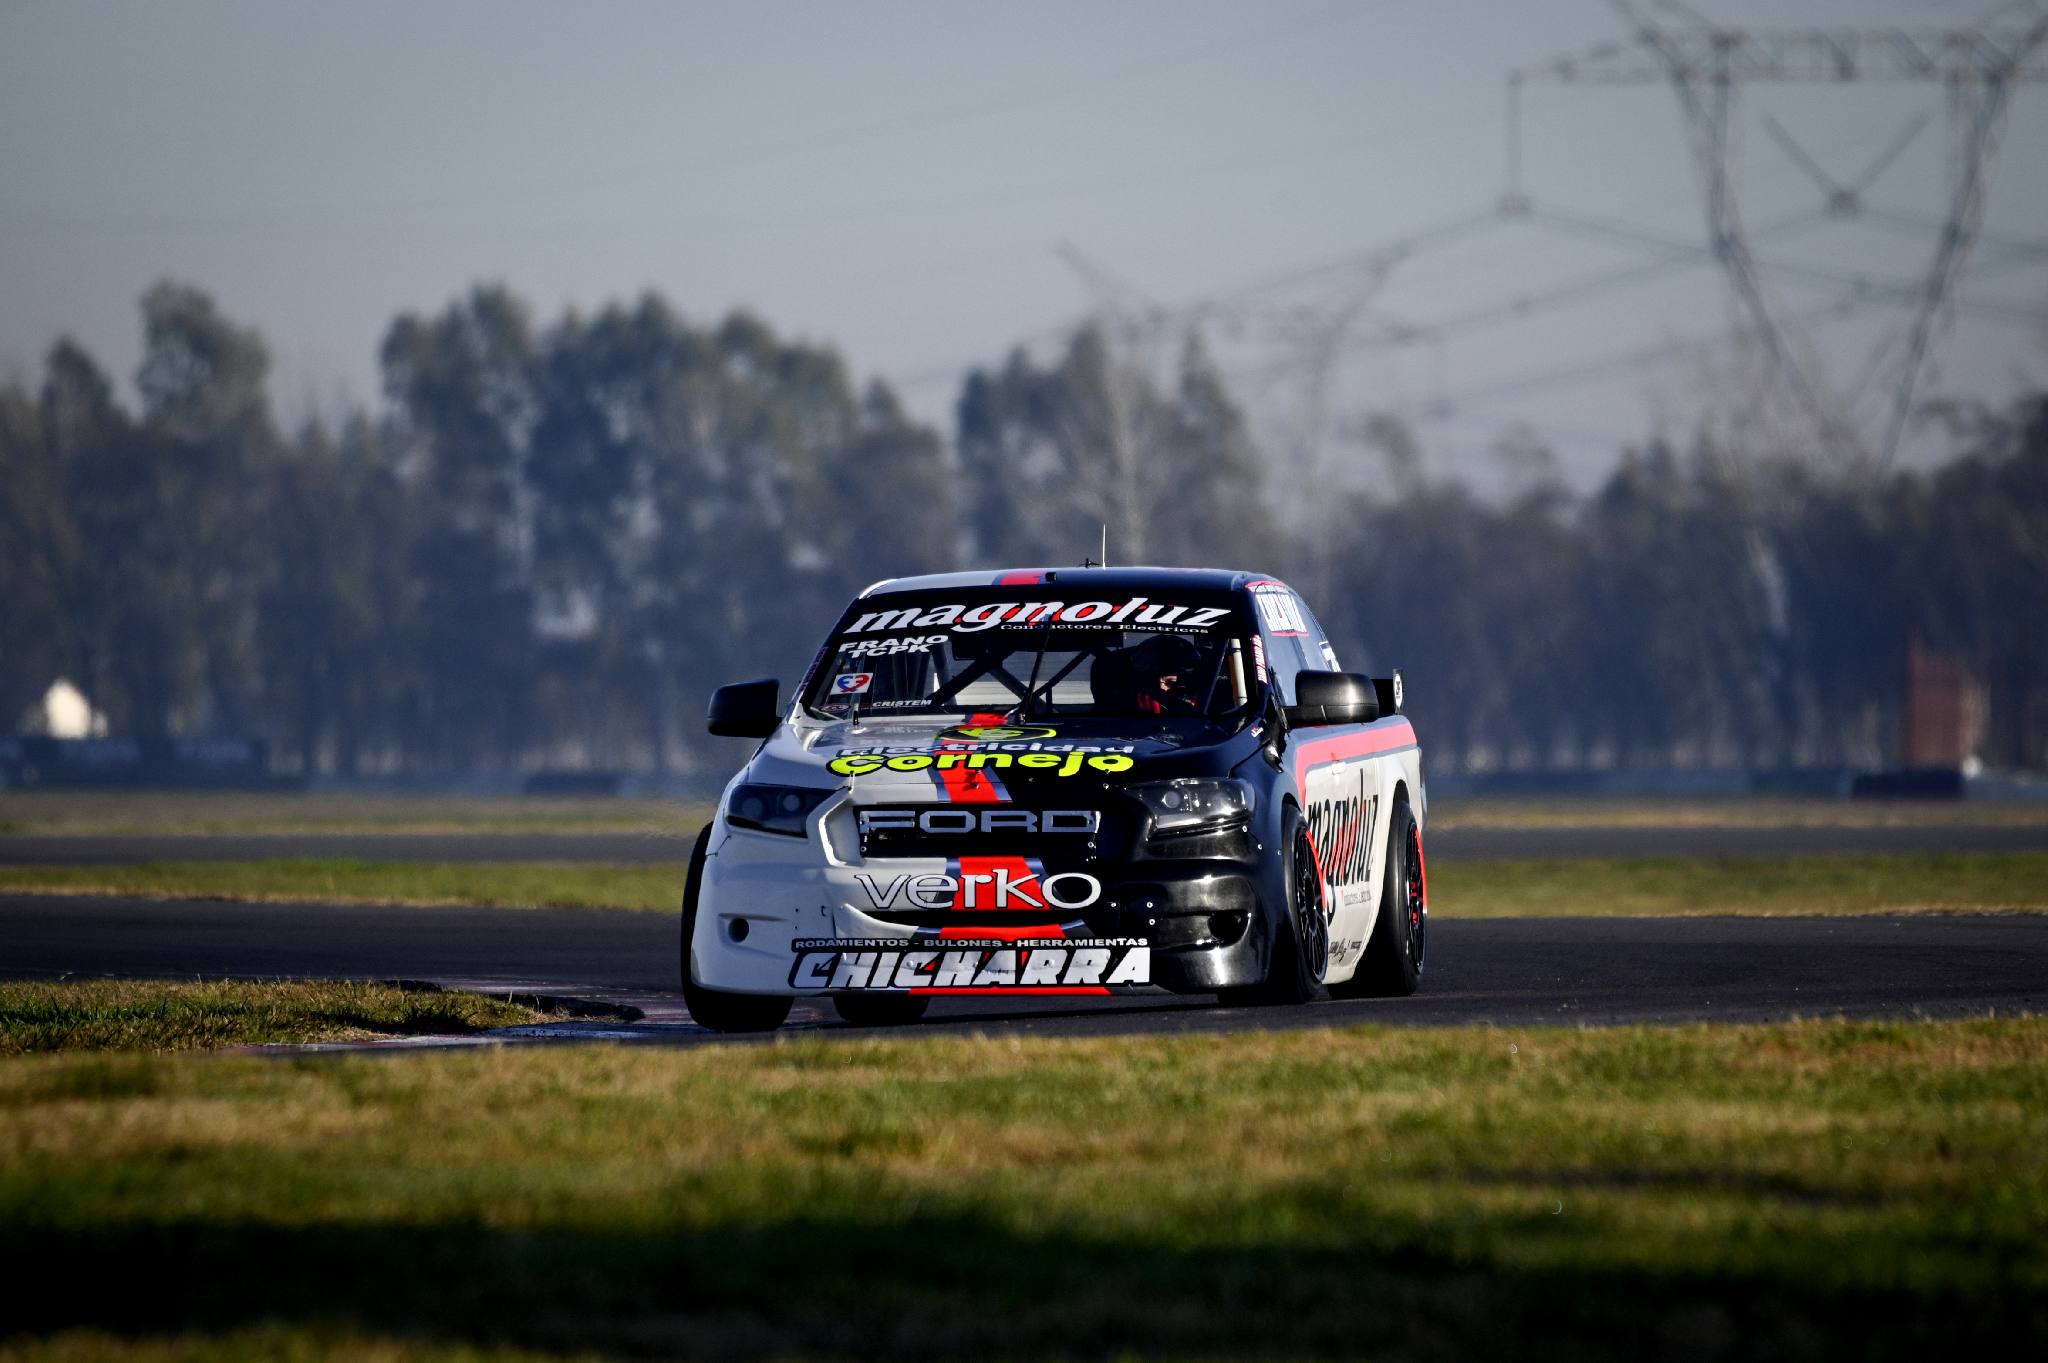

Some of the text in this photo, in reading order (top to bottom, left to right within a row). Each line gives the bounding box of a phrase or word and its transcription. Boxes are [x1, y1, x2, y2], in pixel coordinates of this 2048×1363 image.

[842, 597, 1231, 634] magnoluz
[1119, 623, 1209, 634] Electricos
[838, 635, 949, 652] FRANO
[848, 644, 934, 658] TCPK
[860, 810, 1100, 834] FORD
[854, 868, 1101, 910] verko
[795, 938, 908, 948] RODAMIENTOS
[924, 939, 1002, 948] BULONES
[1017, 937, 1148, 947] HERRAMIENTAS
[790, 946, 1151, 989] CHICHARRA
